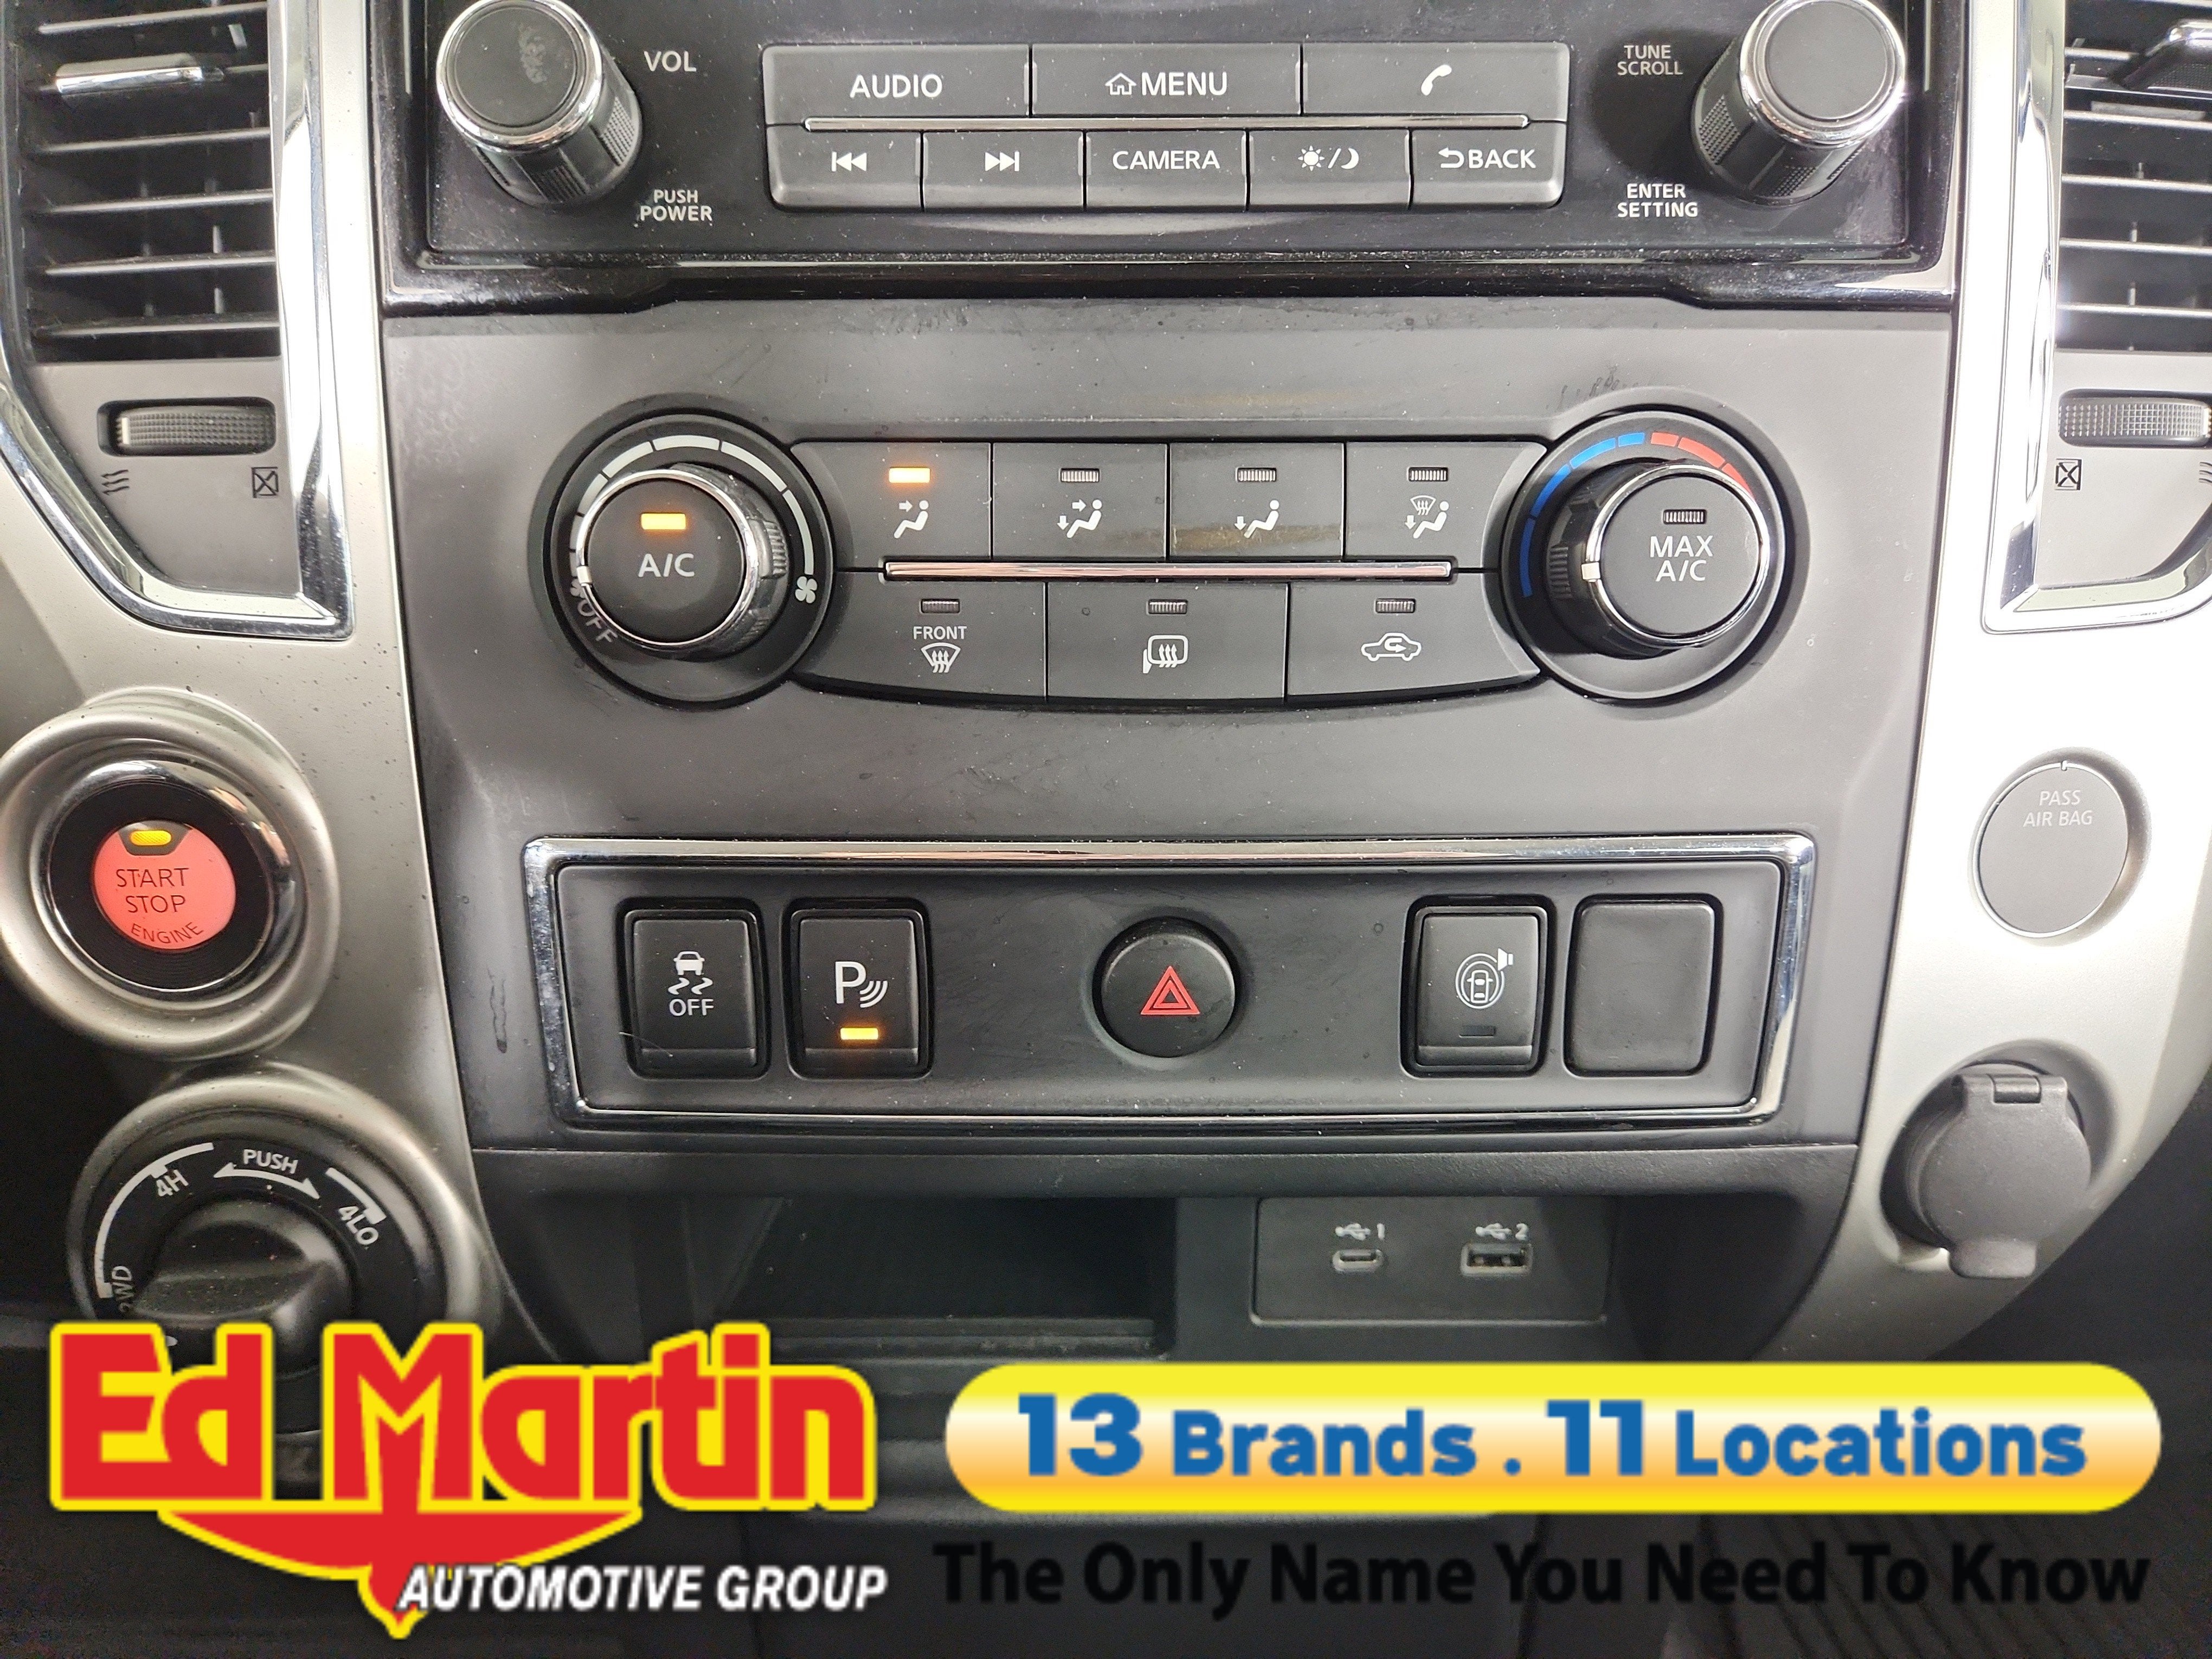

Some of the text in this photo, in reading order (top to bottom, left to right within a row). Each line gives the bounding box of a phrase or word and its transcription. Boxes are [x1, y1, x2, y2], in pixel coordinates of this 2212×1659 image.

[644, 51, 697, 72] VOL
[1624, 45, 1671, 60] TUNE
[1617, 61, 1683, 75] SCROLL
[850, 74, 943, 98] AUDIO
[1141, 72, 1228, 95] MENU
[1112, 151, 1220, 170] CAMERA
[1468, 150, 1536, 169] BACK
[653, 190, 698, 204] PUSH
[1627, 183, 1686, 199] ENTER
[640, 205, 712, 222] POWER
[1617, 202, 1698, 217] SETTING
[1649, 535, 1713, 558] MAX
[638, 553, 695, 577] A/C
[1655, 560, 1707, 581] A/C
[577, 600, 618, 644] OFF
[913, 626, 967, 640] FRONT
[2039, 790, 2081, 806] PASS
[2023, 810, 2093, 827] AIR BAG
[115, 868, 189, 888] START
[125, 895, 186, 914] STOP
[130, 922, 204, 944] ENGINE
[835, 961, 866, 1004] P
[668, 999, 714, 1016] OFF
[243, 1149, 299, 1174] PUSH
[156, 1169, 189, 1198] 4H
[338, 1205, 379, 1246] 4LO
[1515, 1223, 1528, 1240] 2
